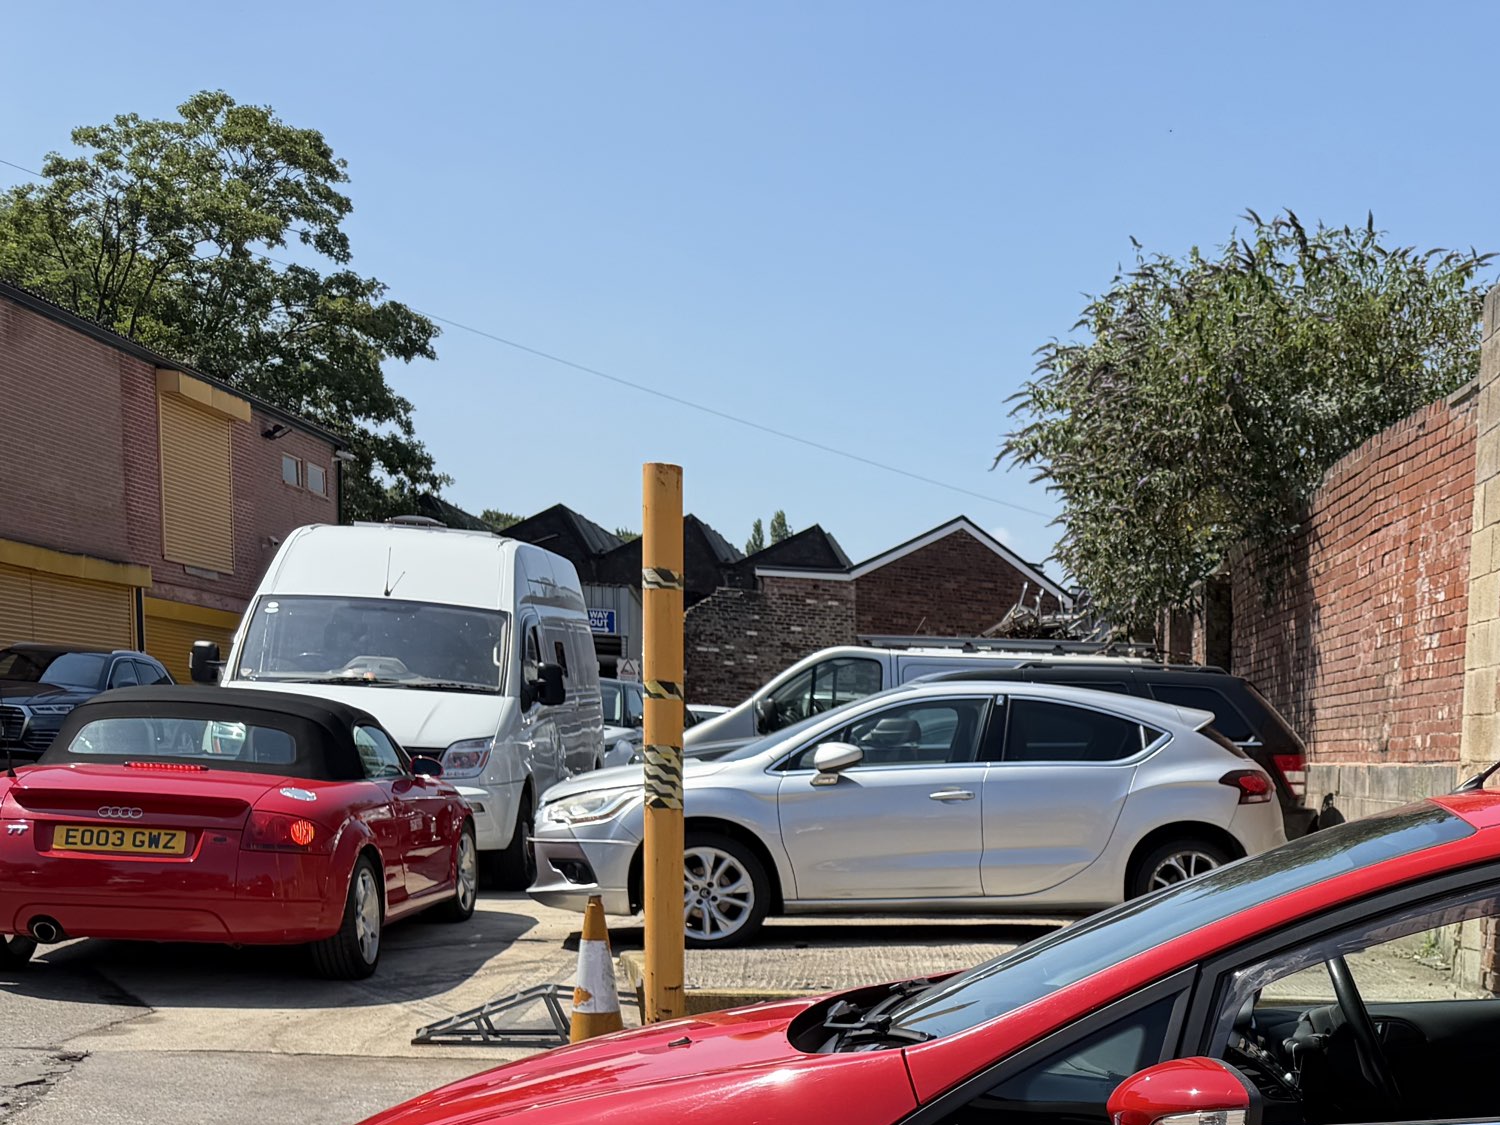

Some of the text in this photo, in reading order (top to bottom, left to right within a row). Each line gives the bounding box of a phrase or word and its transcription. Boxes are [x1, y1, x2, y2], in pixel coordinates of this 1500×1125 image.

[589, 610, 609, 619] WAY
[589, 619, 609, 627] OUT
[131, 831, 177, 850] GWZ
